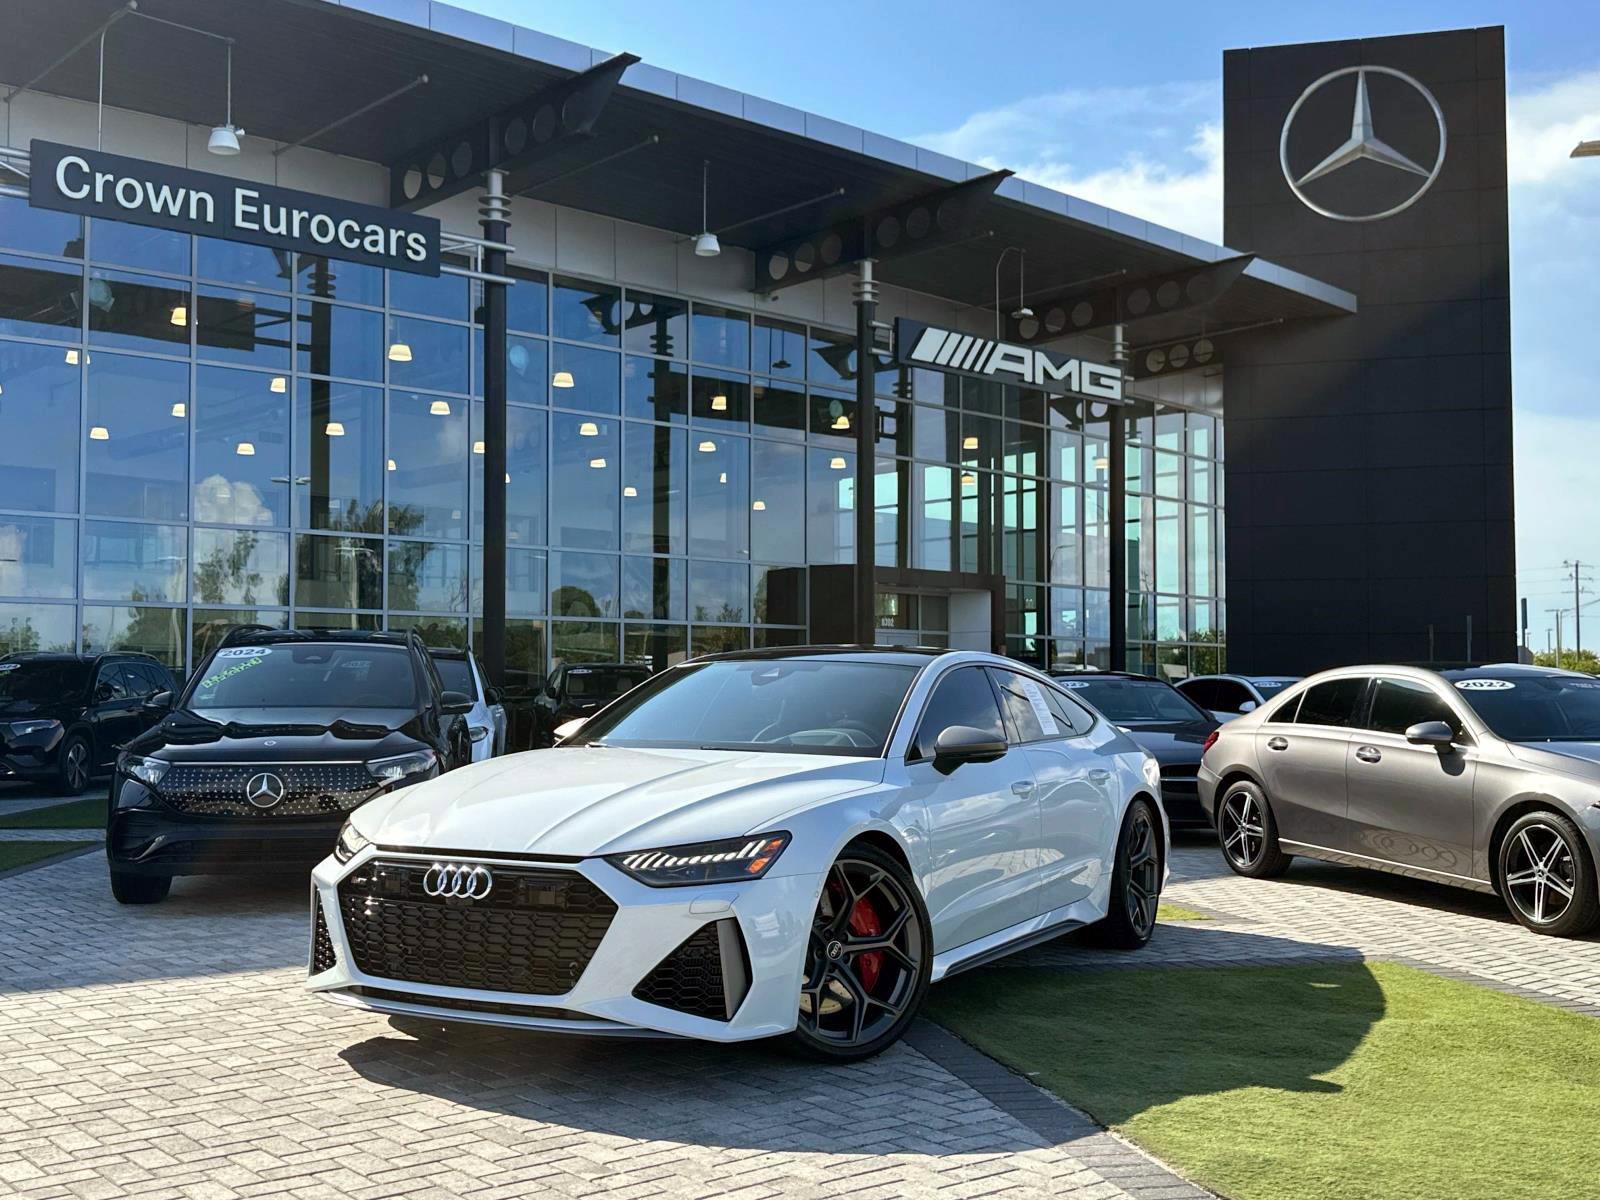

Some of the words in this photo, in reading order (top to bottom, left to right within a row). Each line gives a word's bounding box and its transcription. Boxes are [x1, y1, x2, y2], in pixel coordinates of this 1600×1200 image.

[55, 156, 215, 223] Crown
[234, 187, 428, 262] Eurocars
[982, 342, 1122, 400] AMG
[220, 648, 267, 656] 2024
